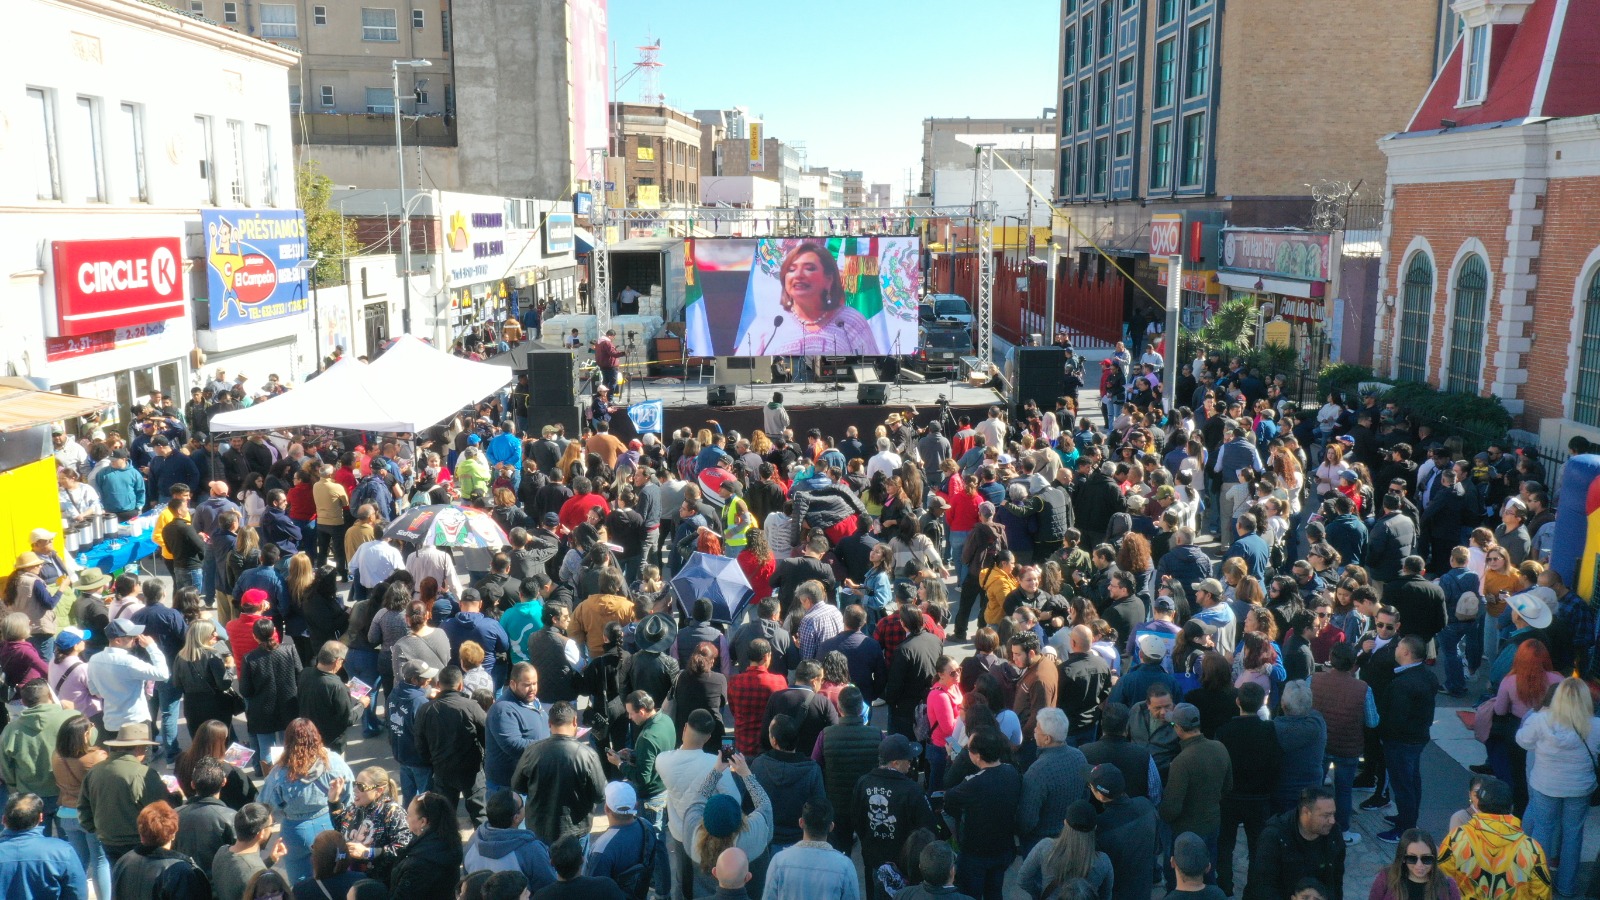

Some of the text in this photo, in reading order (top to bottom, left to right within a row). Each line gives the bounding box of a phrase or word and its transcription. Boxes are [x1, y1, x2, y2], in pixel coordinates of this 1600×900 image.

[238, 213, 305, 240] PRÉSTAMOS
[1151, 223, 1178, 254] OXXO
[1263, 236, 1277, 263] City
[77, 258, 148, 294] CIRCLE
[234, 272, 243, 287] El
[242, 270, 275, 287] Campeón
